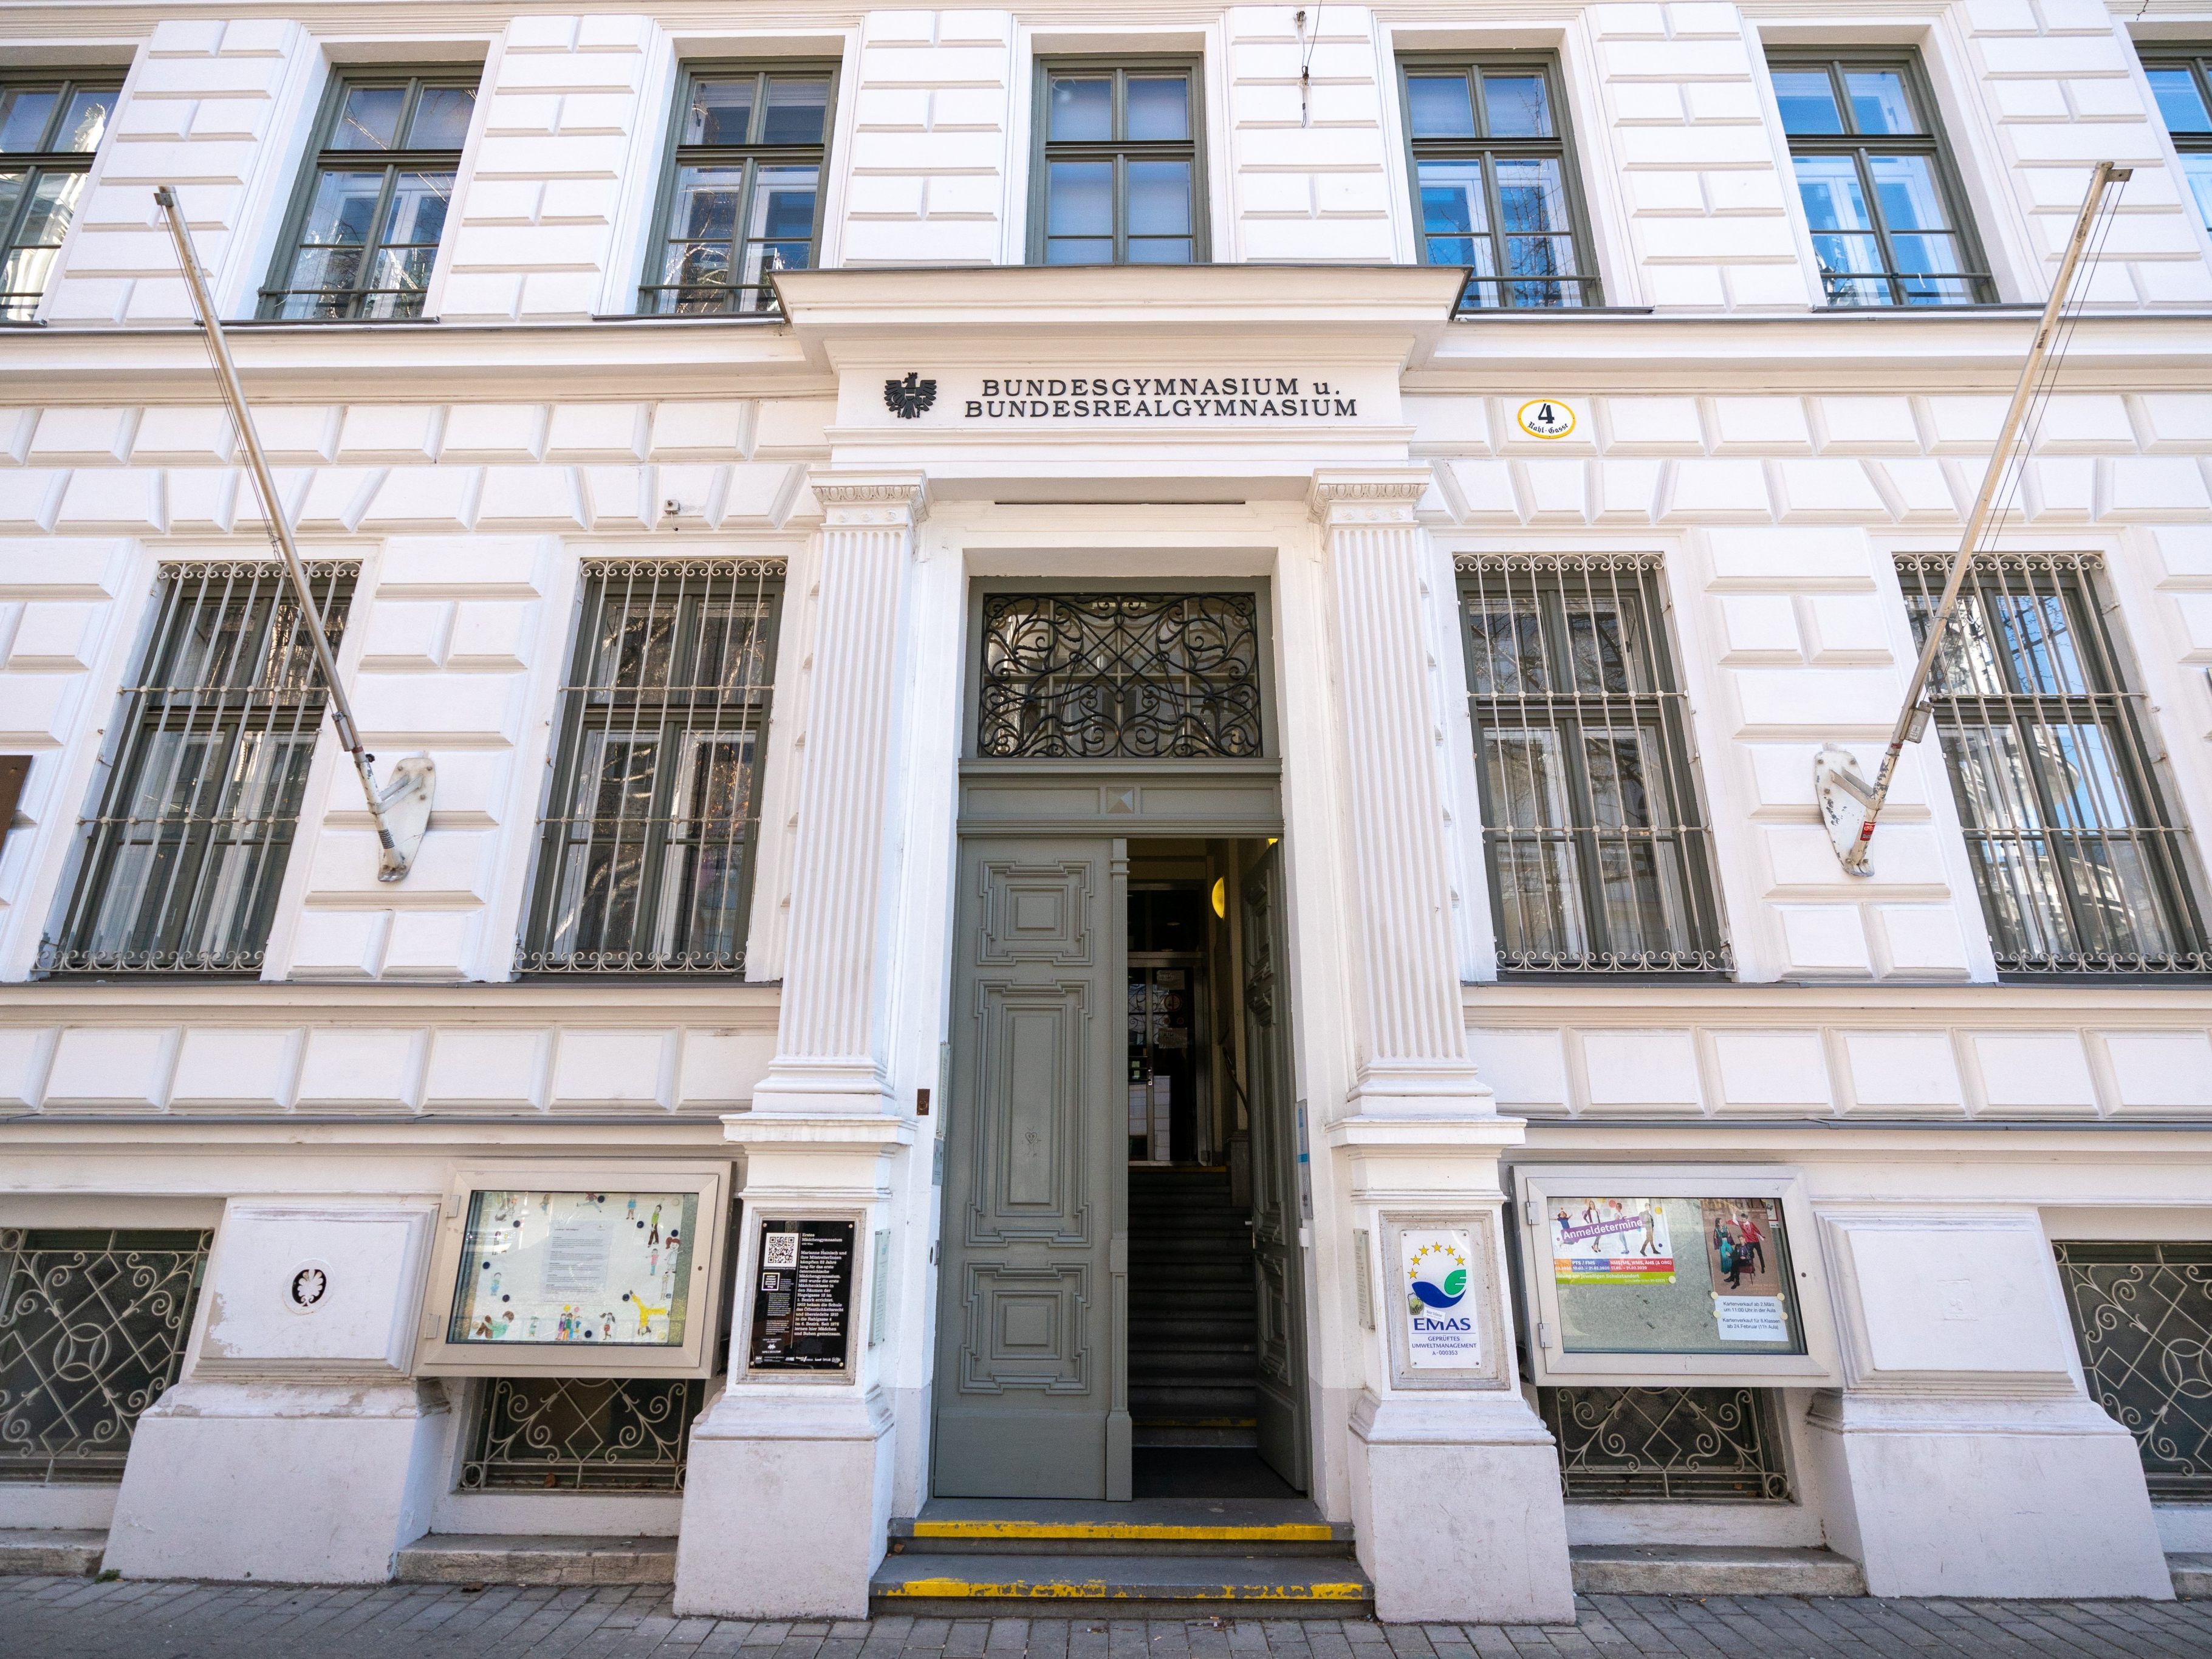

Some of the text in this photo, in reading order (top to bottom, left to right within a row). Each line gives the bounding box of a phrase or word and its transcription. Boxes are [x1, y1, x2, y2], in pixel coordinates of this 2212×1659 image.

[982, 378, 1340, 396] BUNDESGYMNASIUM u.
[965, 399, 1357, 417] BUNDESREALGYMNASIUM
[1538, 403, 1555, 424] 4
[1563, 1219, 1643, 1240] Anmeldetermine
[1414, 1318, 1471, 1330] EMAS
